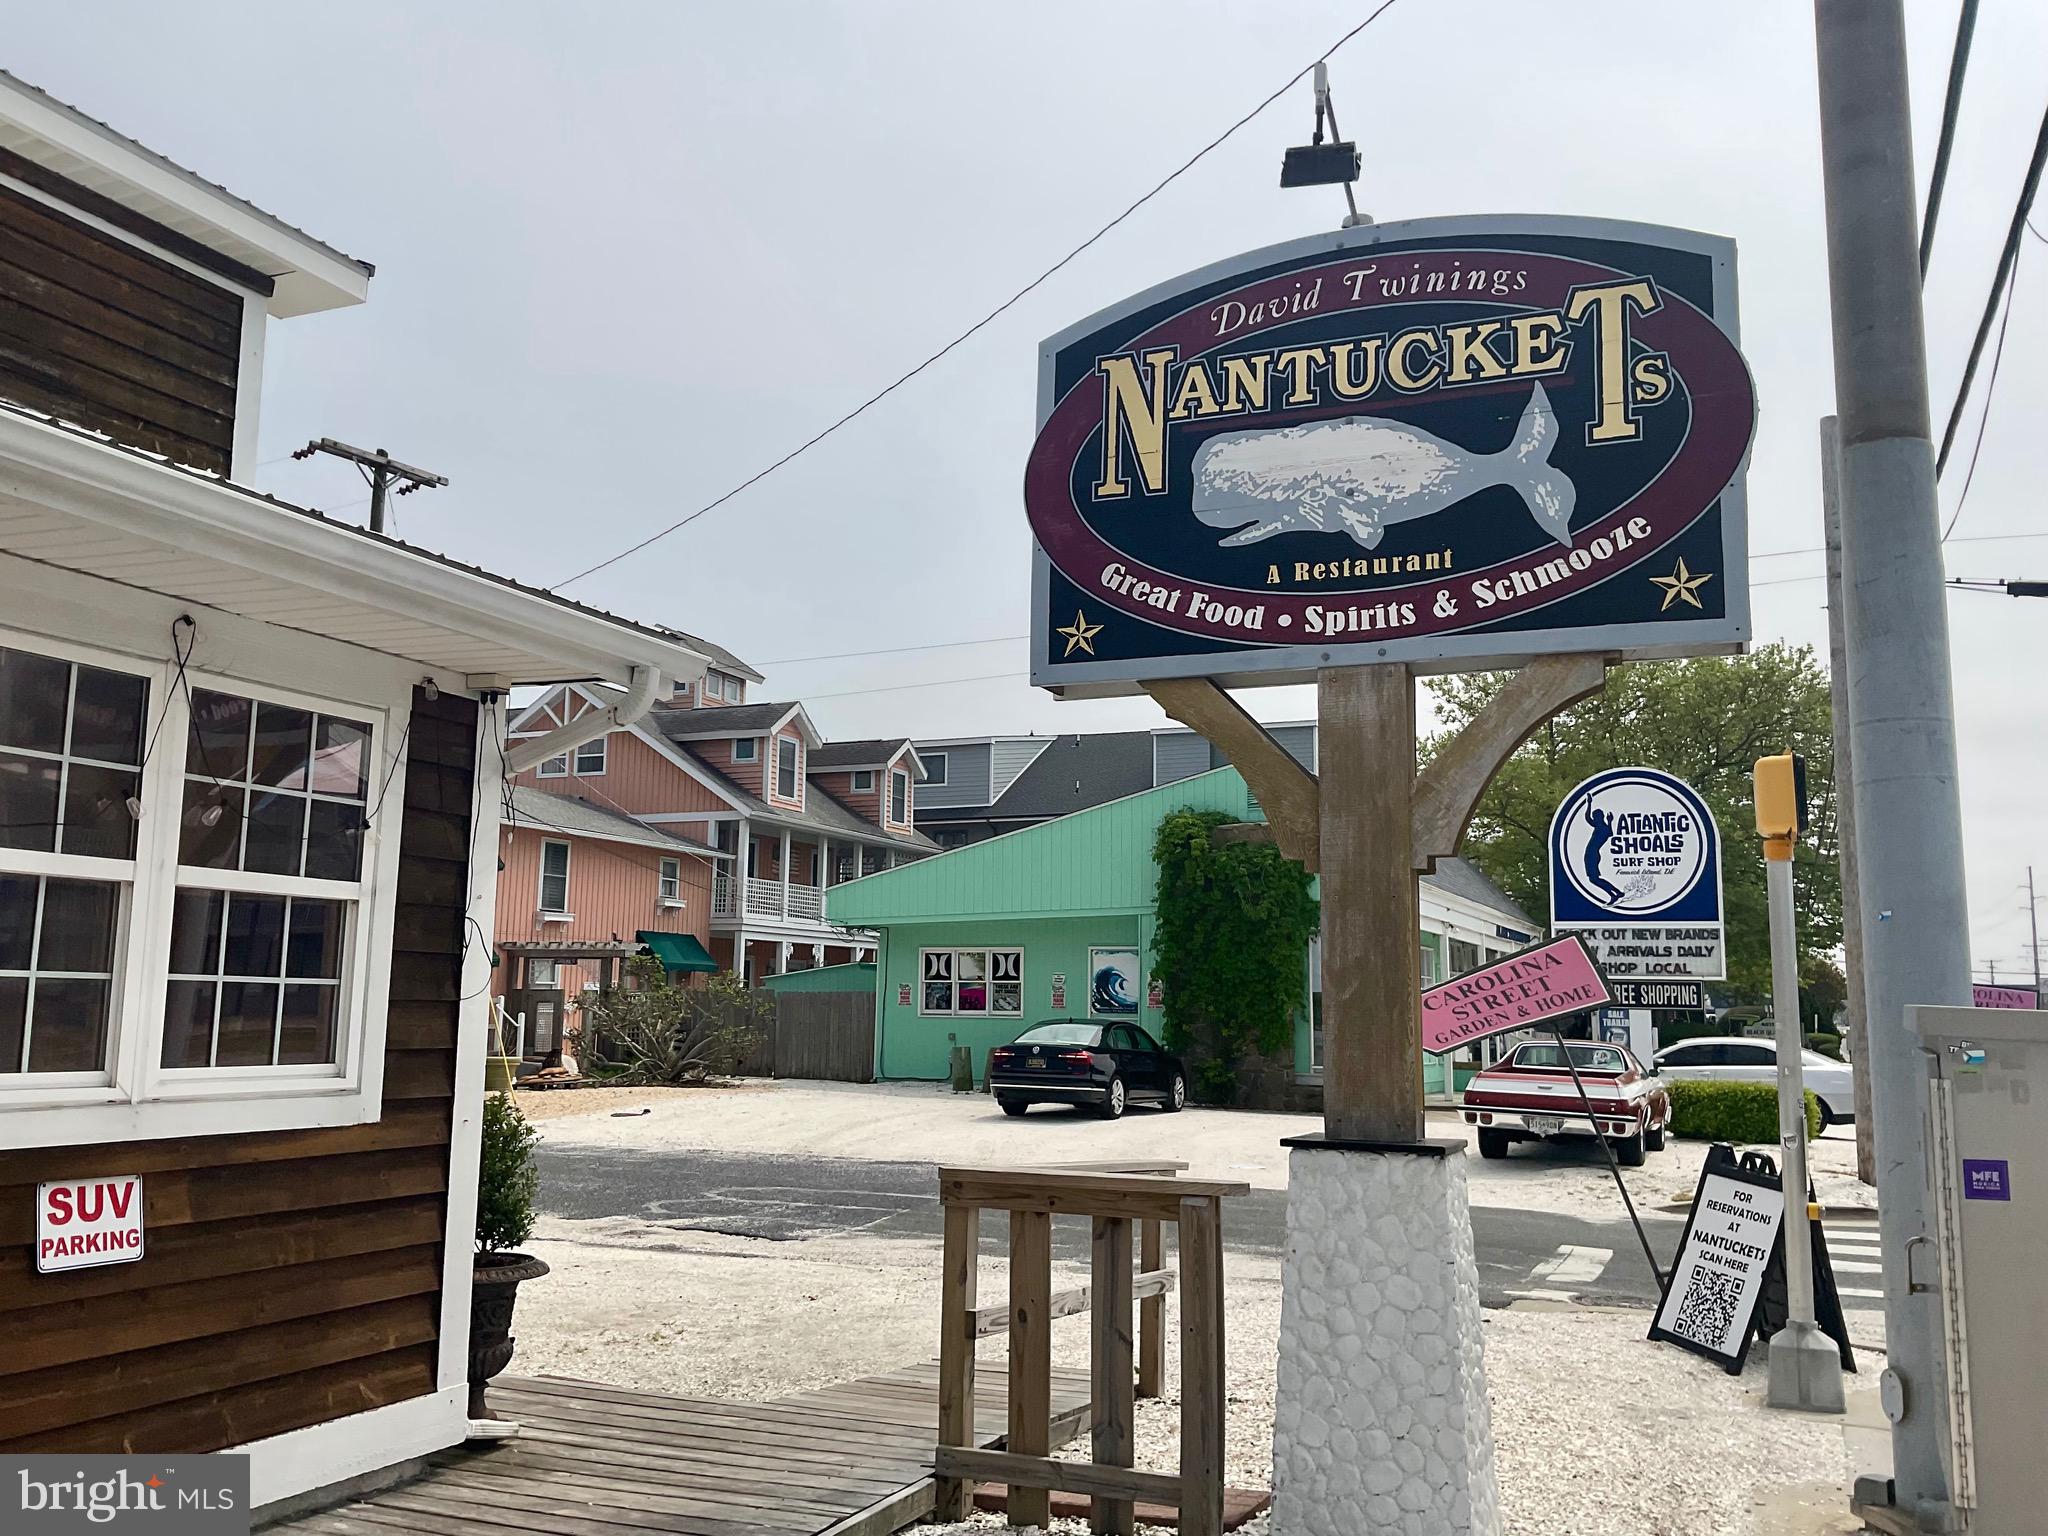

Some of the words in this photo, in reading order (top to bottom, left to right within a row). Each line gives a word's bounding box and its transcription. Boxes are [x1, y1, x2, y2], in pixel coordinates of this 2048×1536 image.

[1210, 277, 1323, 337] David
[1342, 261, 1528, 302] Twinings
[1101, 562, 1182, 613] Great
[1185, 591, 1266, 631] Food
[1304, 600, 1418, 636] Spirits
[1433, 589, 1459, 618] &
[1471, 516, 1652, 609] Schmooze
[1266, 564, 1281, 585] A
[1294, 548, 1453, 583] Restaurant
[1609, 833, 1684, 855] SHOALS
[1612, 856, 1645, 867] SURF
[1647, 856, 1682, 867] SHOP
[1601, 928, 1627, 940] OUT
[1631, 928, 1661, 940] NEW
[1665, 928, 1719, 941] BRANDS
[1606, 945, 1672, 957] ARRIVALS
[1677, 945, 1715, 957] DAILY
[1423, 952, 1563, 1011] CAROLINA
[1601, 962, 1637, 974] SHOP
[1645, 962, 1692, 974] LOCAL
[1451, 974, 1552, 1022] STREET
[1611, 984, 1636, 1005] REE
[1641, 984, 1698, 1006] SHOPPING
[1435, 1010, 1511, 1045] GARDEN
[1517, 1005, 1531, 1018] &
[1535, 983, 1596, 1013] HOME
[46, 1181, 135, 1226] SUV
[1733, 1190, 1753, 1204] FOR
[1706, 1199, 1772, 1226] RESERVATIONS
[1727, 1221, 1741, 1233] AT
[40, 1228, 140, 1260] PARKING
[1692, 1229, 1767, 1261] NANTUCKETS
[1698, 1249, 1723, 1265] SCAN
[1723, 1257, 1750, 1274] HERE
